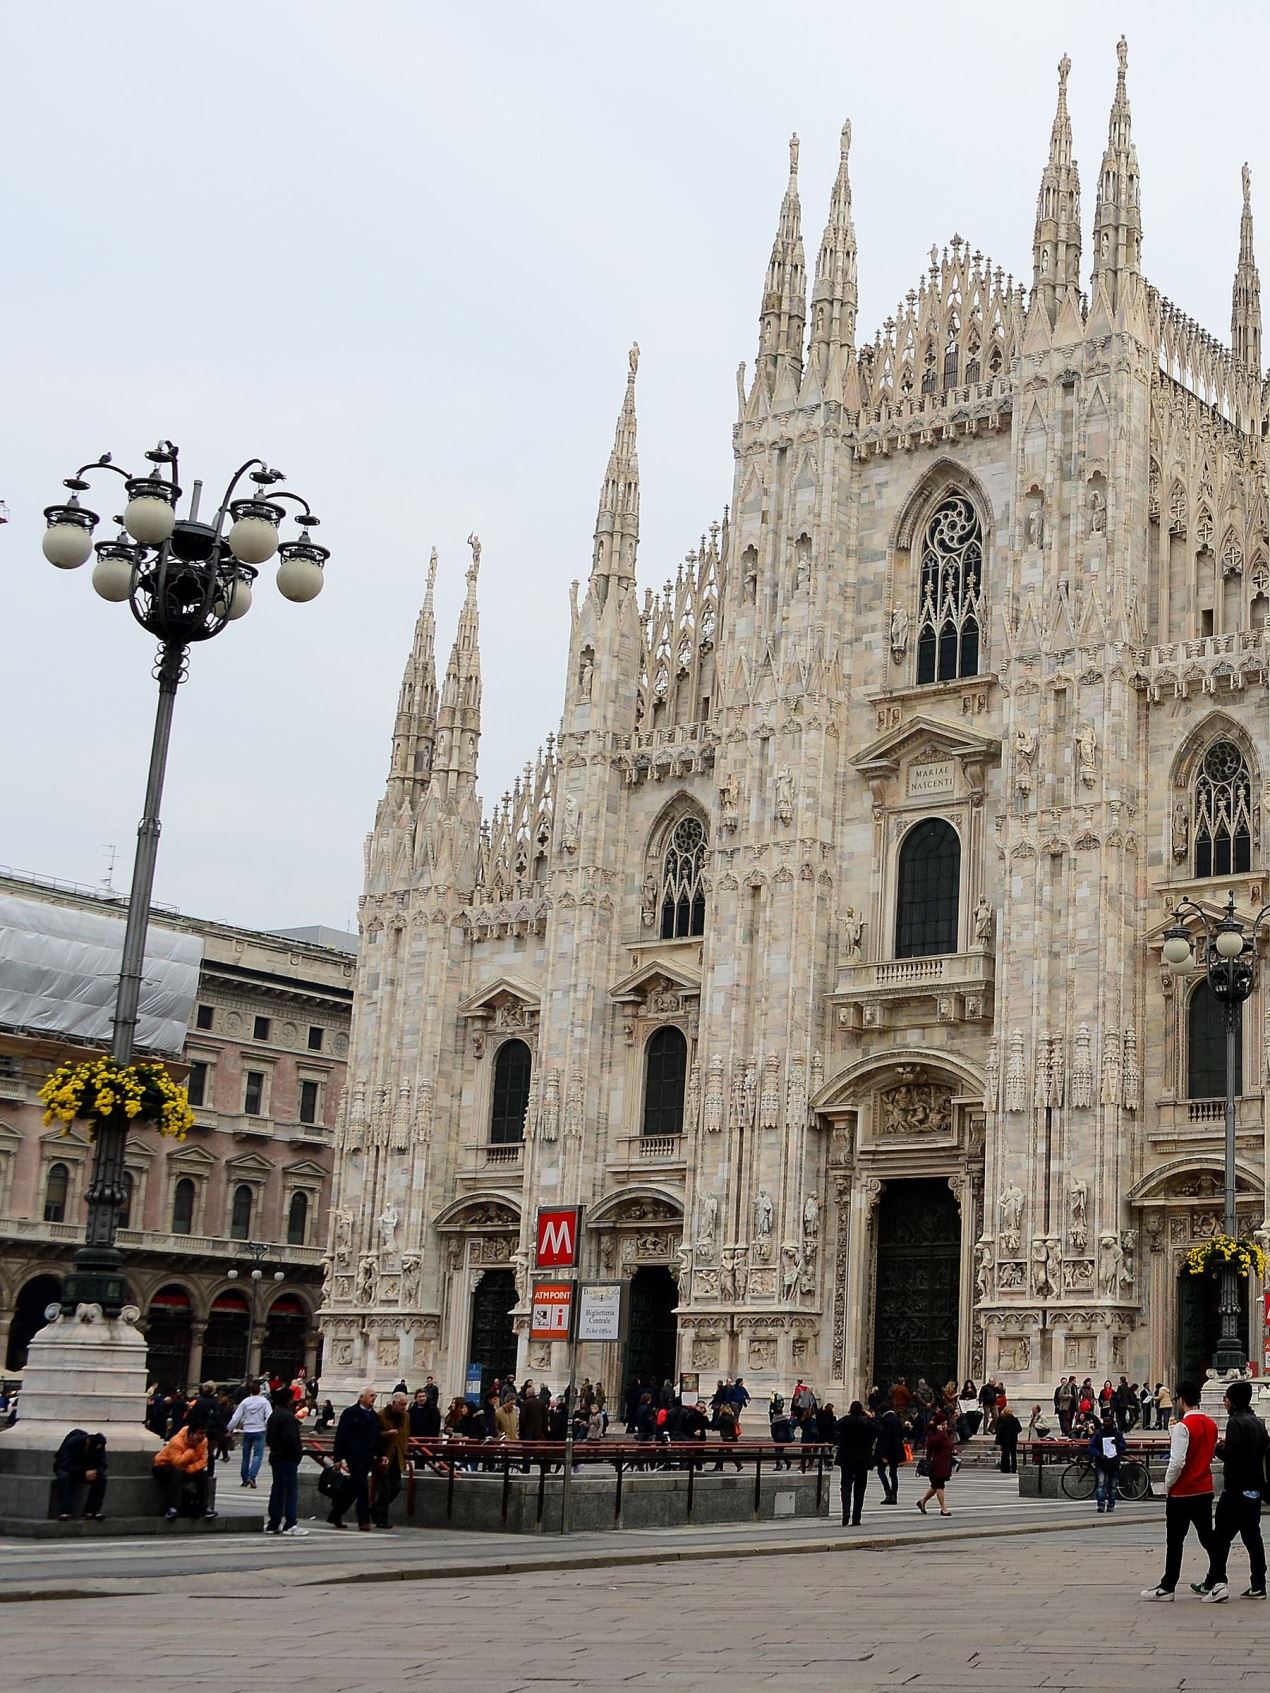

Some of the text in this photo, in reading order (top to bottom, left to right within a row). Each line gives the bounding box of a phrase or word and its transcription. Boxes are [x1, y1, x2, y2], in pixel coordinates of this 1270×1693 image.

[915, 766, 949, 778] MARIAE
[911, 778, 953, 790] NASCENTI
[540, 1221, 572, 1254] M
[534, 1291, 571, 1299] ATM POINT
